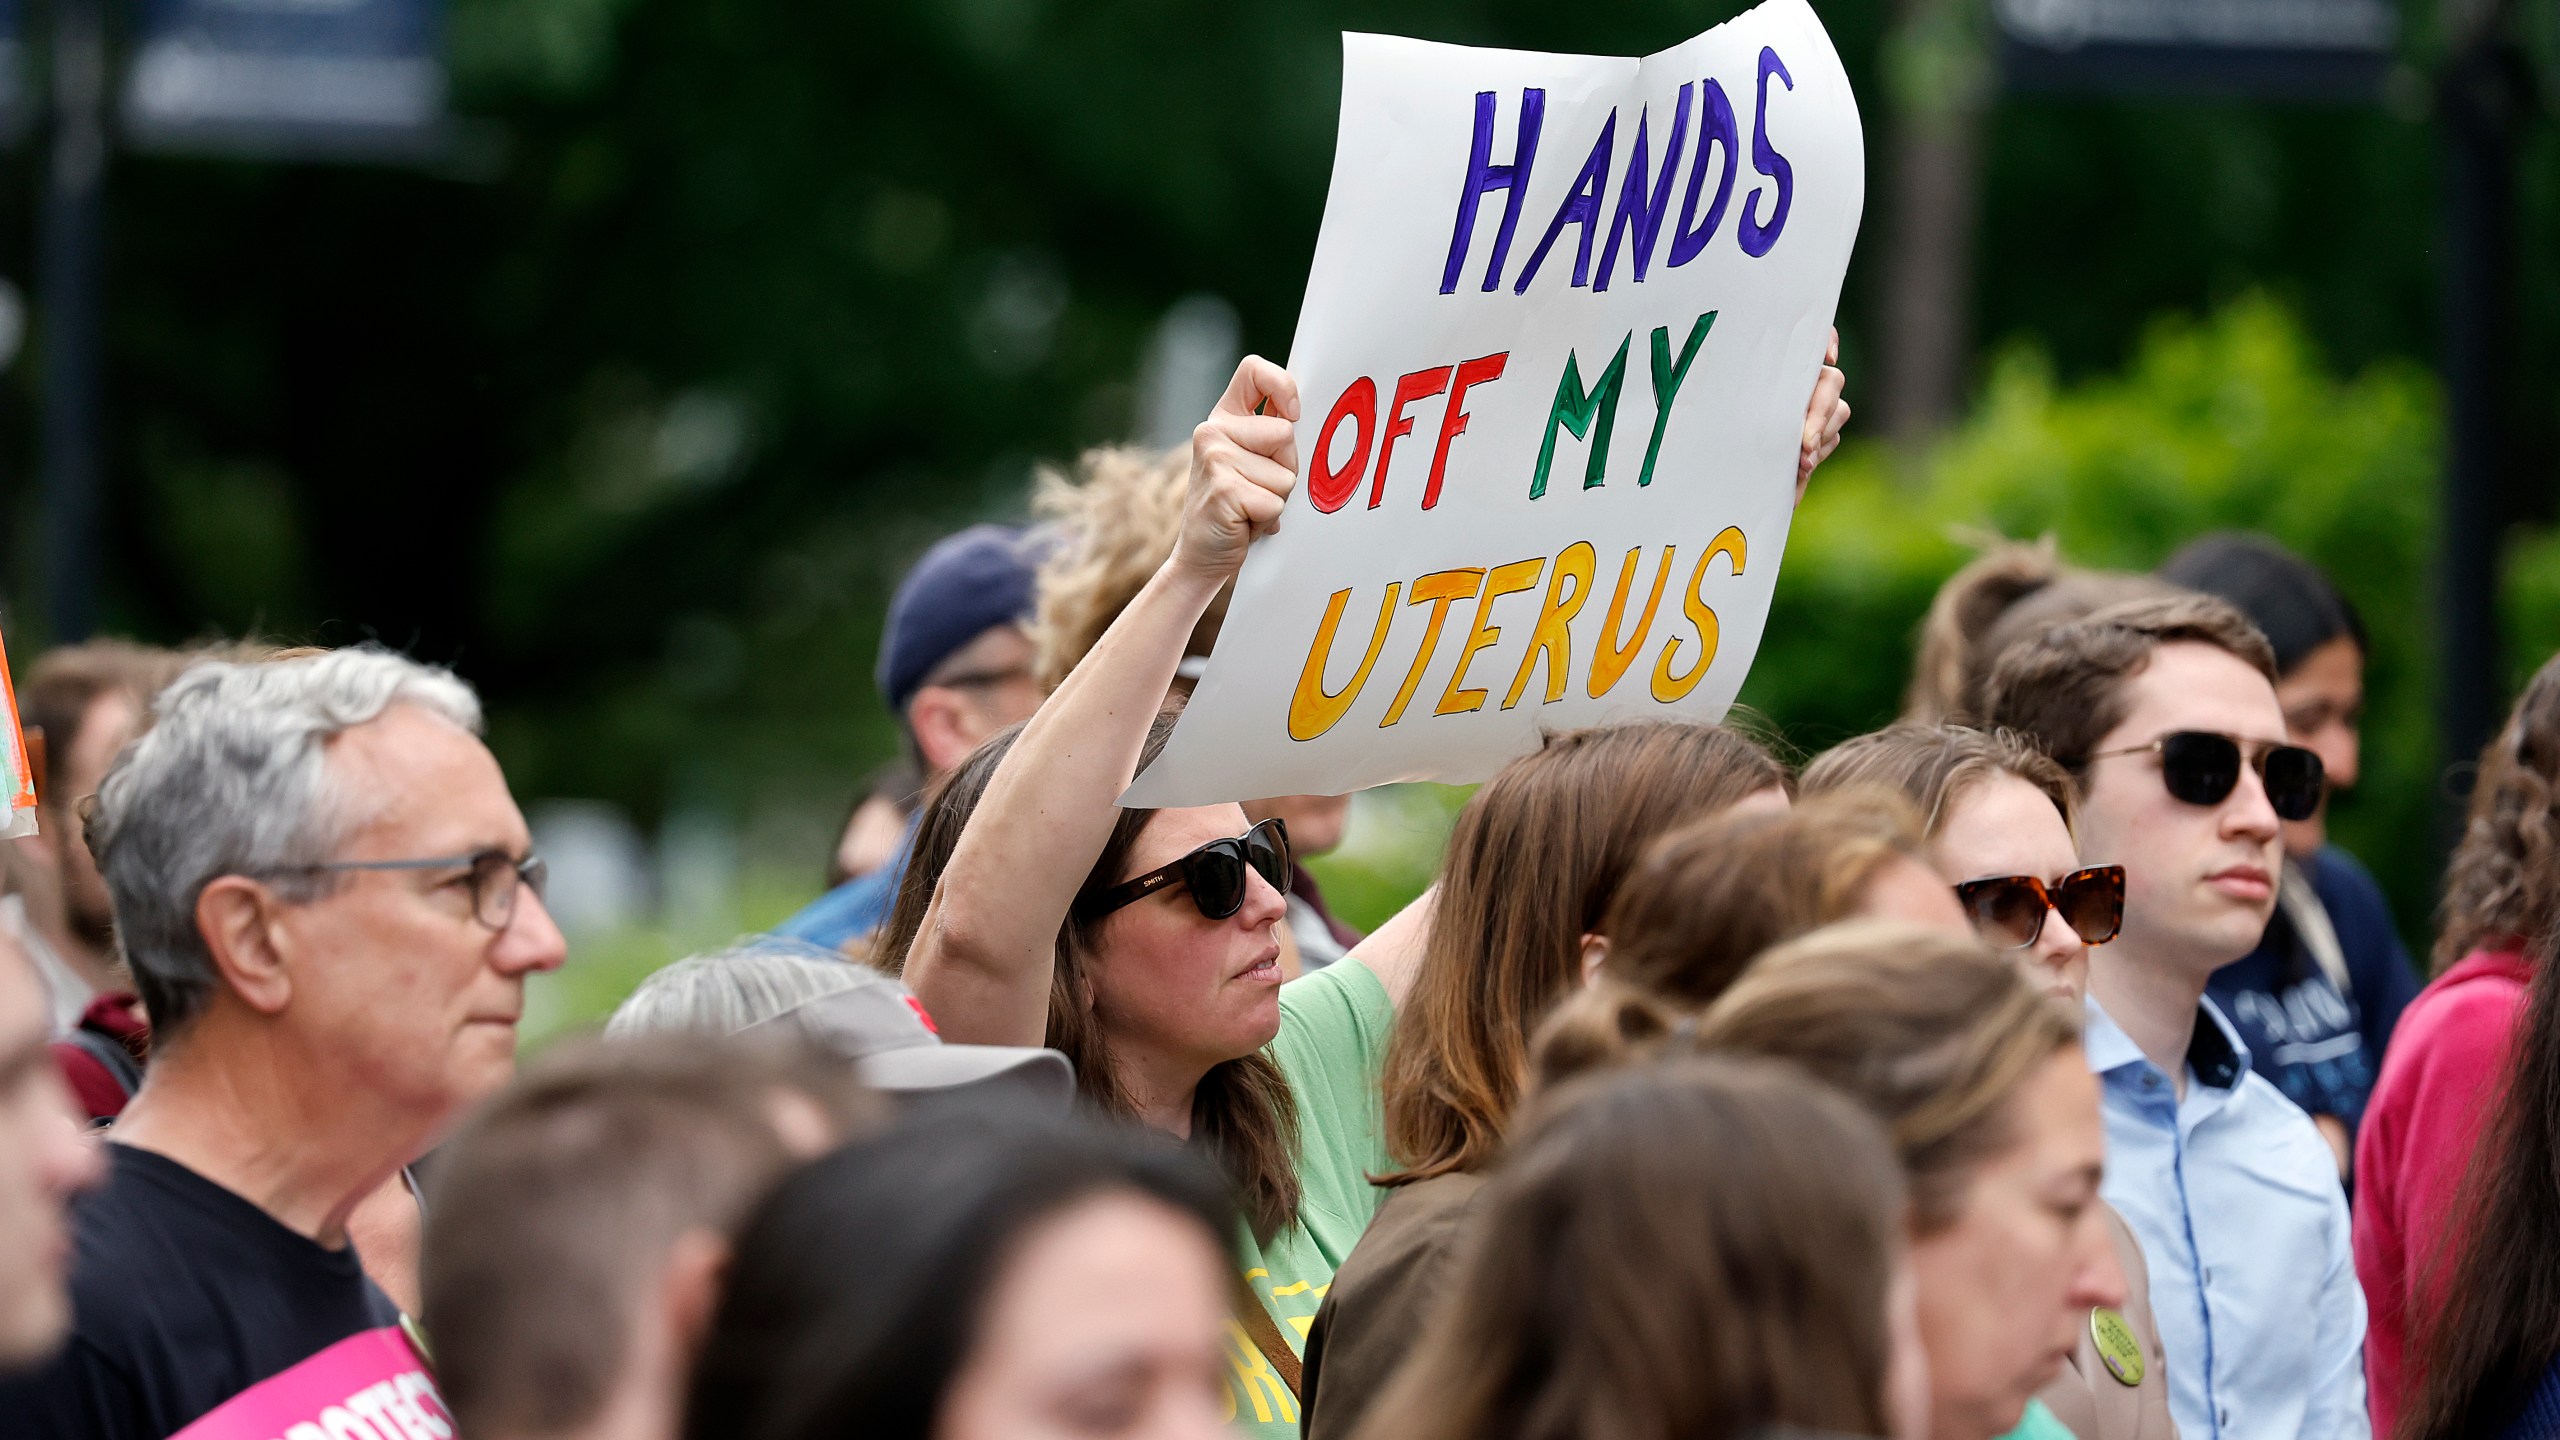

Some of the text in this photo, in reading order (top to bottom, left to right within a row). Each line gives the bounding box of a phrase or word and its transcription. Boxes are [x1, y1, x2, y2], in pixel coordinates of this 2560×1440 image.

[1440, 46, 1794, 296] HANDS
[1308, 310, 1718, 514] OFF MY
[1287, 526, 1747, 742] UTERUS
[1143, 874, 1164, 888] SMITH
[267, 1370, 453, 1440] OTEC
